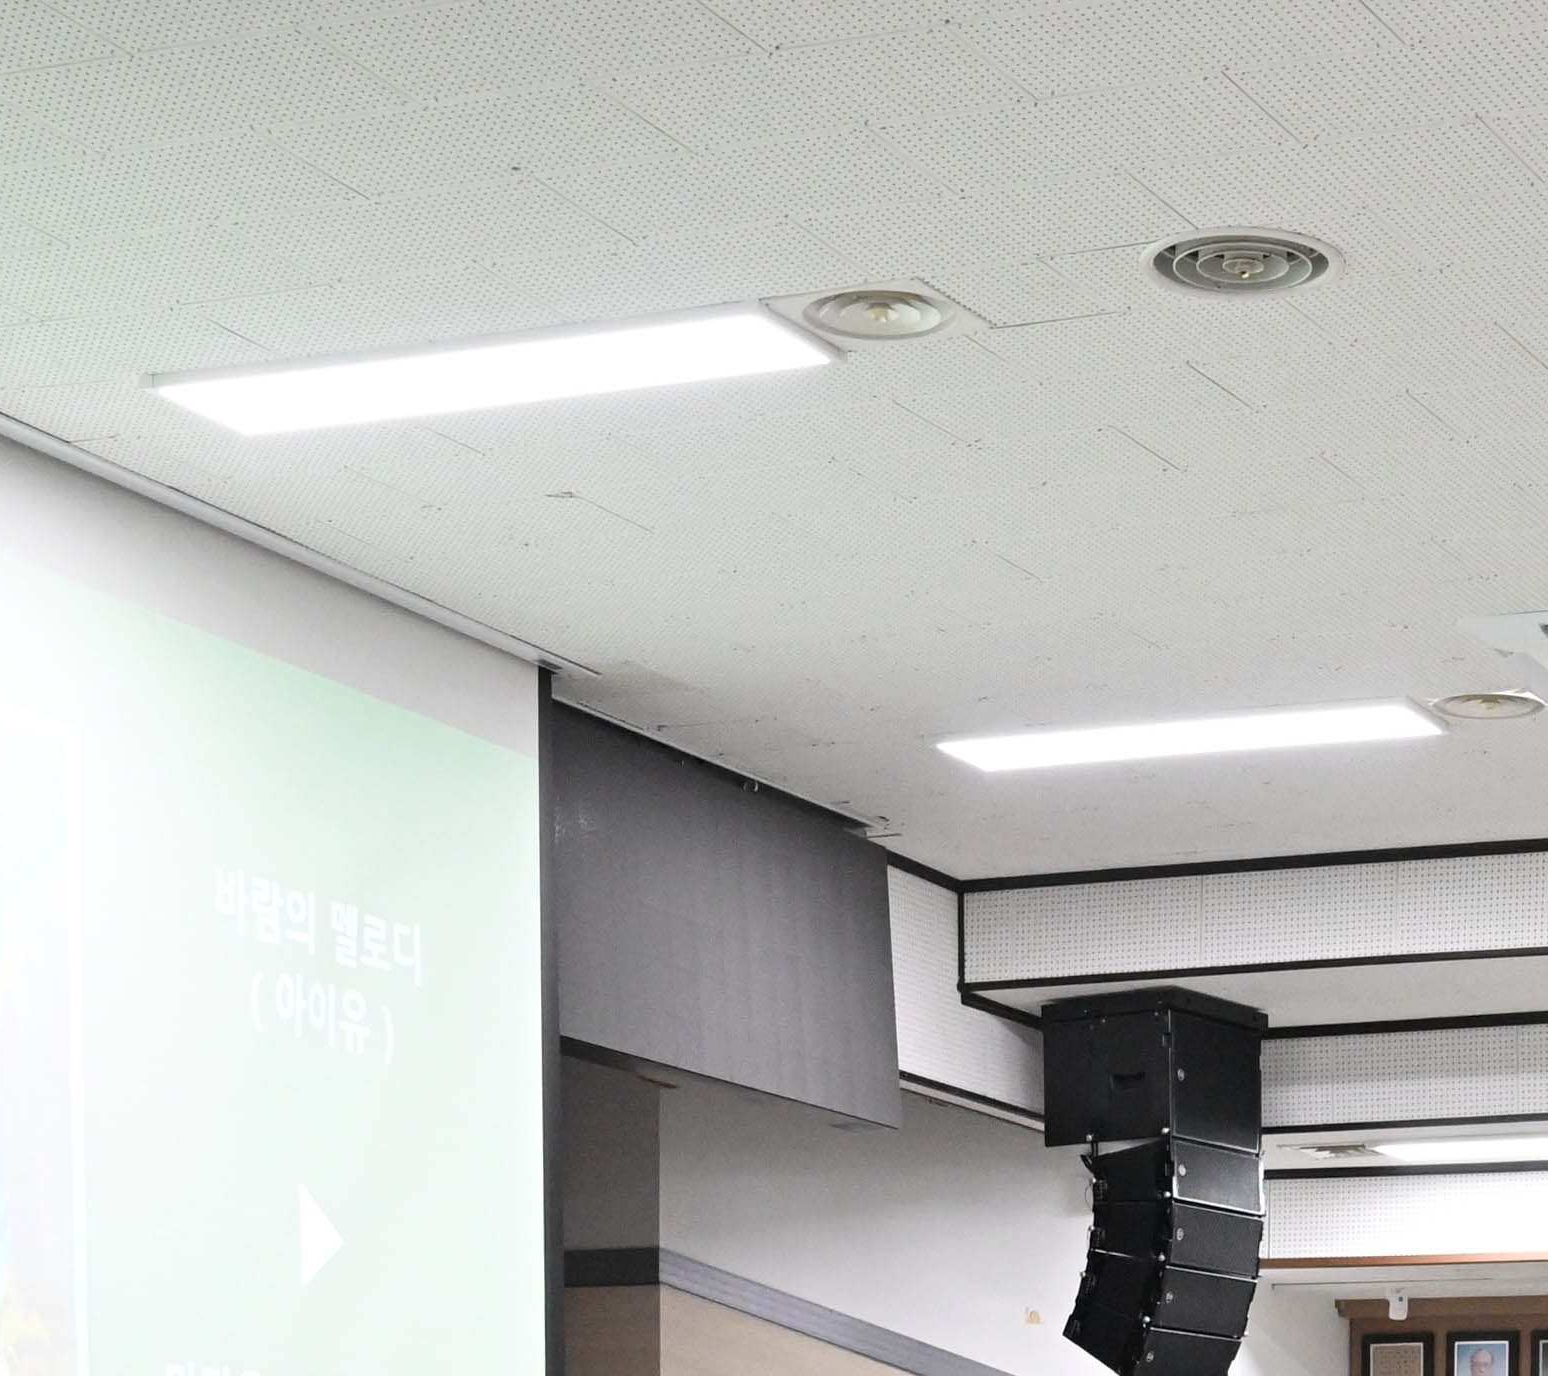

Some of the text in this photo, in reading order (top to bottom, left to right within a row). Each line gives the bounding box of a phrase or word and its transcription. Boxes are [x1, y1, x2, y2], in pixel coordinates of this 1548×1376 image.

[214, 868, 421, 987] 바람의 멜로디
[276, 972, 371, 1055] 아이유
